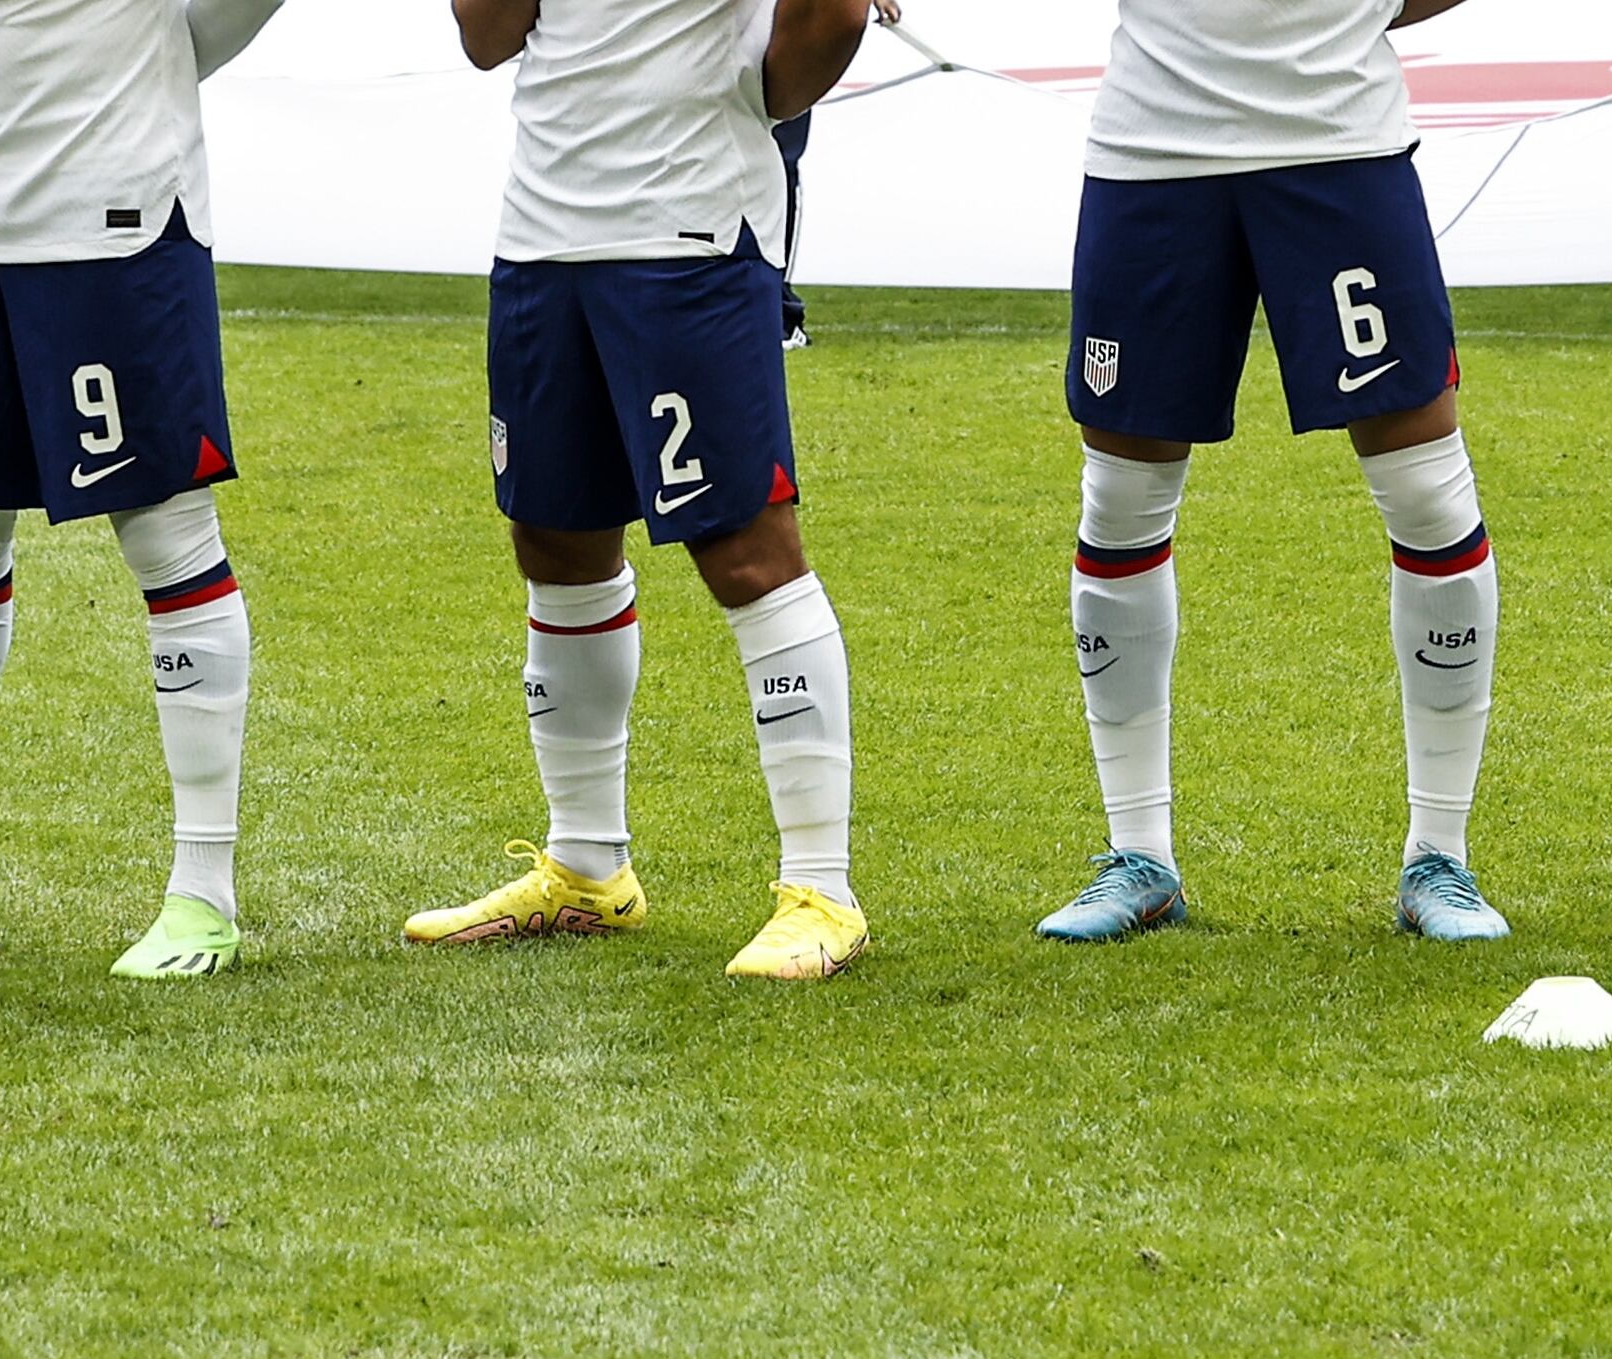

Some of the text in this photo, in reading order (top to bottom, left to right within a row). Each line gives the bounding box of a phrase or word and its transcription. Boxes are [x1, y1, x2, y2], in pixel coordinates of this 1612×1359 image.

[1332, 267, 1388, 357] 6
[1088, 341, 1117, 364] USA
[72, 363, 125, 454] 9
[651, 392, 705, 485] 2
[1428, 627, 1478, 649] USA
[524, 682, 549, 698] SA
[763, 675, 809, 695] USA
